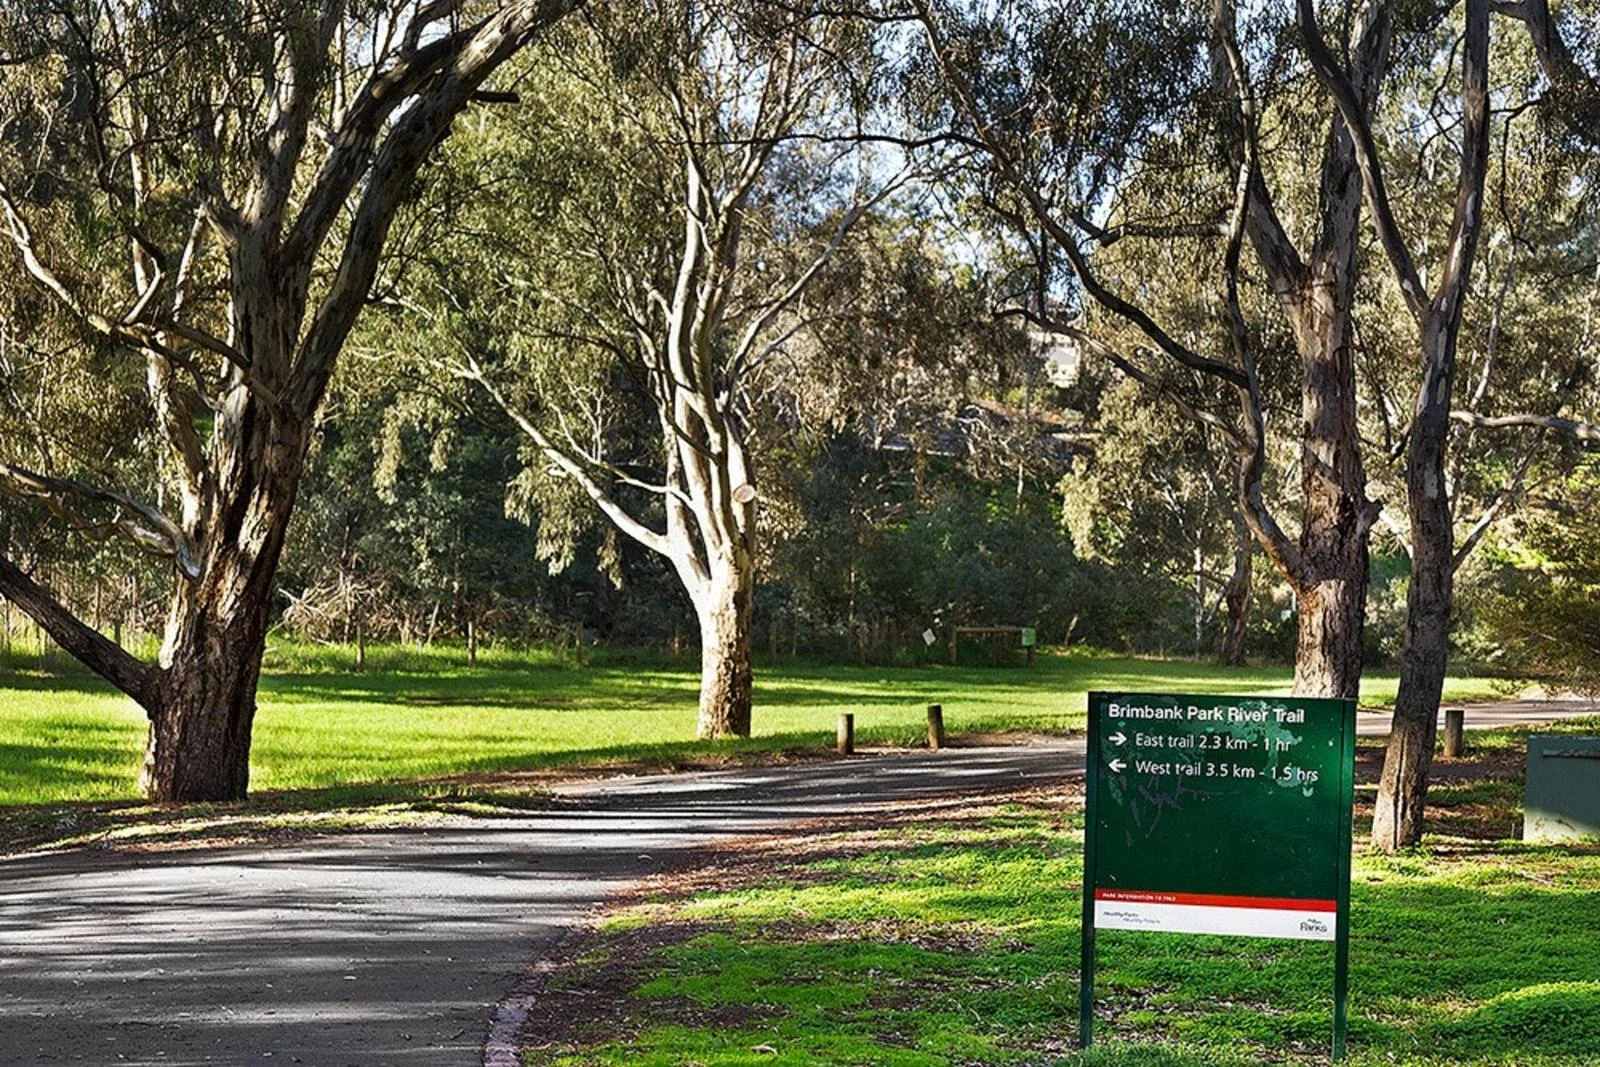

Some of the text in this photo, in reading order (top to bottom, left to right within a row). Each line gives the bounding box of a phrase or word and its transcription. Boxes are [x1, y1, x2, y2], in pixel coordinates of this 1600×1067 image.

[1108, 703, 1306, 724] Brimbank Park River Trail
[1135, 732, 1164, 748] East
[1168, 734, 1196, 749] trail
[1199, 735, 1222, 750] 2.3
[1226, 735, 1248, 751] km
[1264, 738, 1271, 752] 1
[1276, 738, 1292, 753] hr
[1135, 759, 1171, 776] West
[1175, 760, 1202, 777] trail
[1205, 763, 1229, 778] 3.5
[1233, 764, 1256, 779] km
[1271, 766, 1293, 781] 1.5
[1297, 766, 1319, 783] hrs
